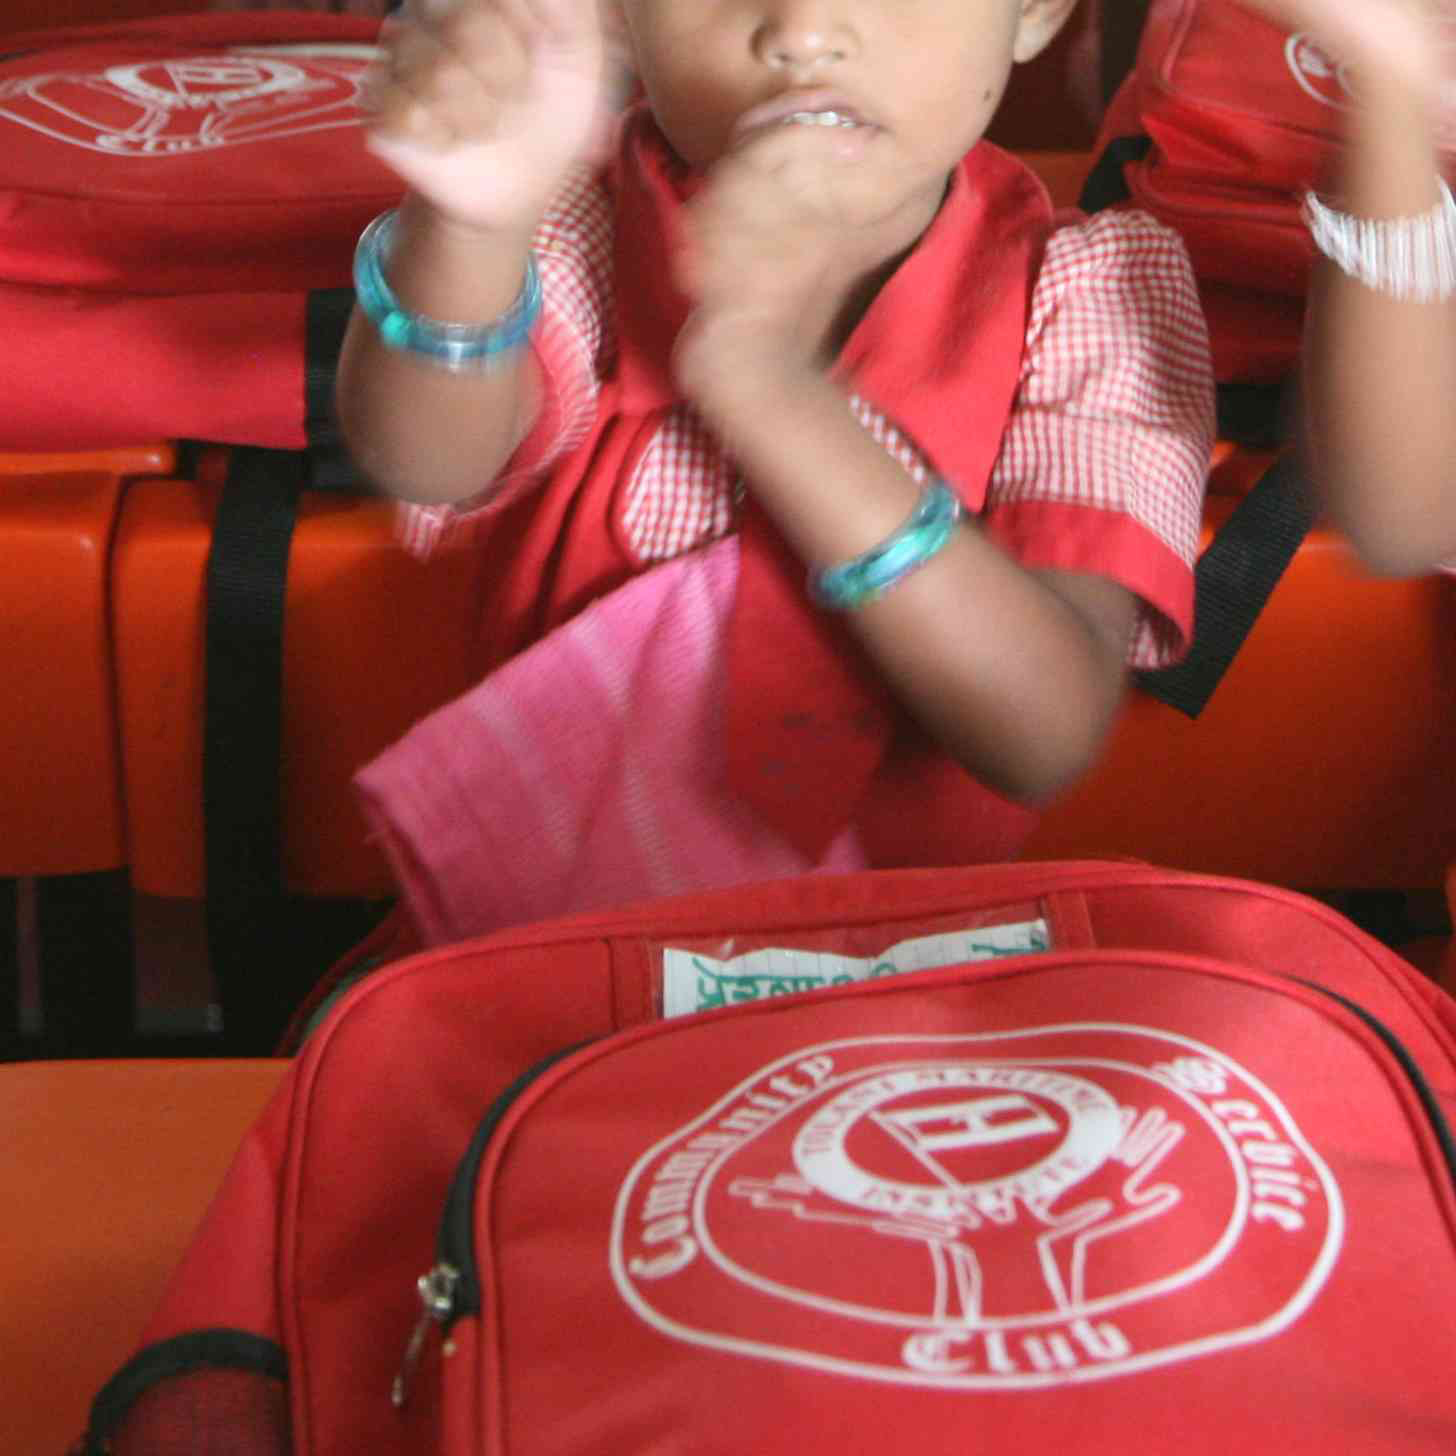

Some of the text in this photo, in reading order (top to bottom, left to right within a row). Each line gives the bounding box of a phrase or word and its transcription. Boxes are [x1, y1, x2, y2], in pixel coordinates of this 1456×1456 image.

[628, 1054, 835, 1280] Community
[1150, 1056, 1320, 1232] Service
[900, 1306, 1134, 1374] Club
